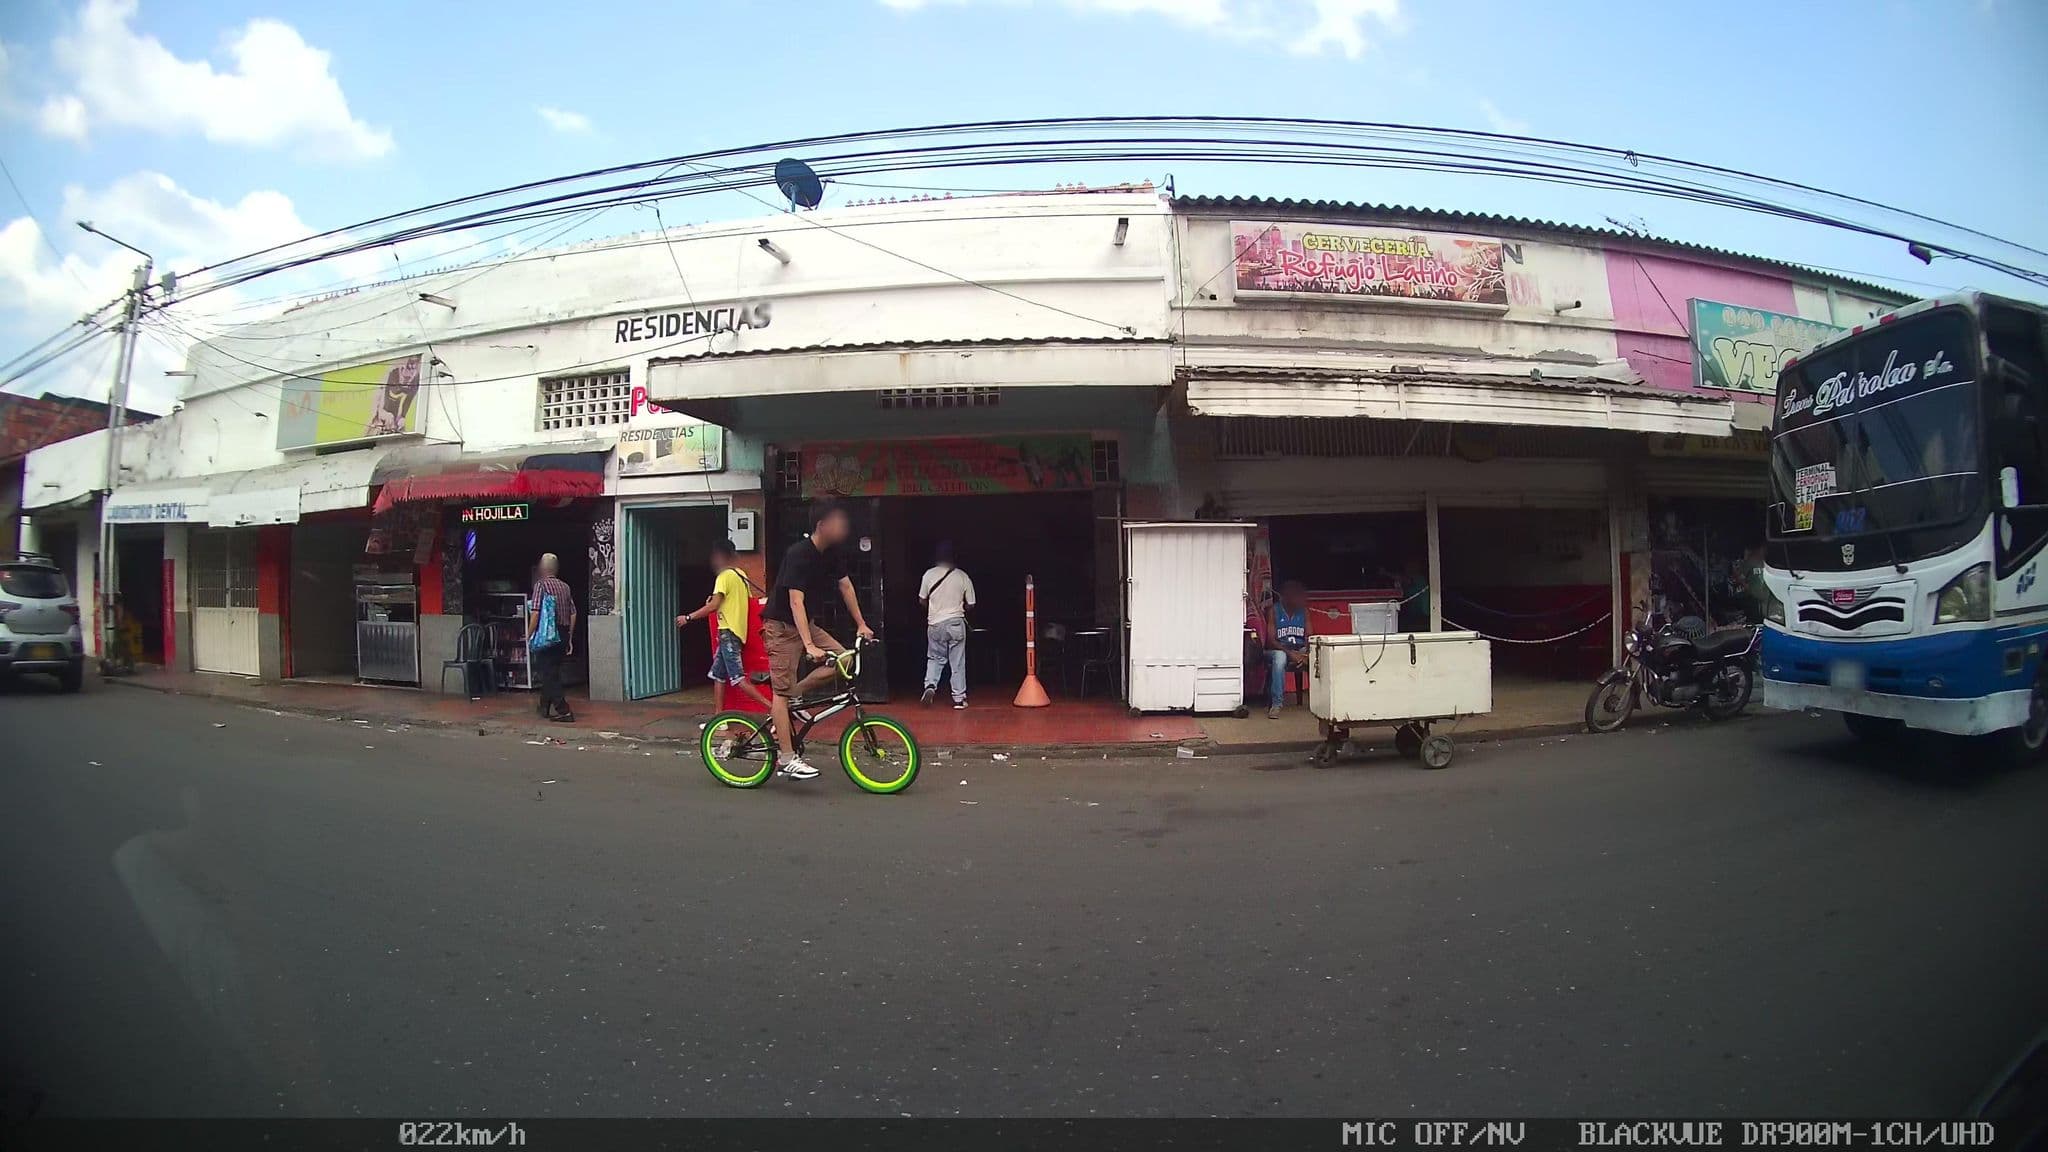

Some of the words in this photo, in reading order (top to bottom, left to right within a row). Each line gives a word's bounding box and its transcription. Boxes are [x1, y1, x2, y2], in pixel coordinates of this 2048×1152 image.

[1381, 254, 1458, 287] Latino
[615, 302, 772, 344] RESIDENCIAS
[1813, 349, 1918, 416] Petrolea
[620, 426, 695, 443] RESIDENCIAS
[1806, 482, 1829, 496] ZULIA
[156, 502, 188, 519] DENTAL
[475, 506, 523, 521] HOJILLA
